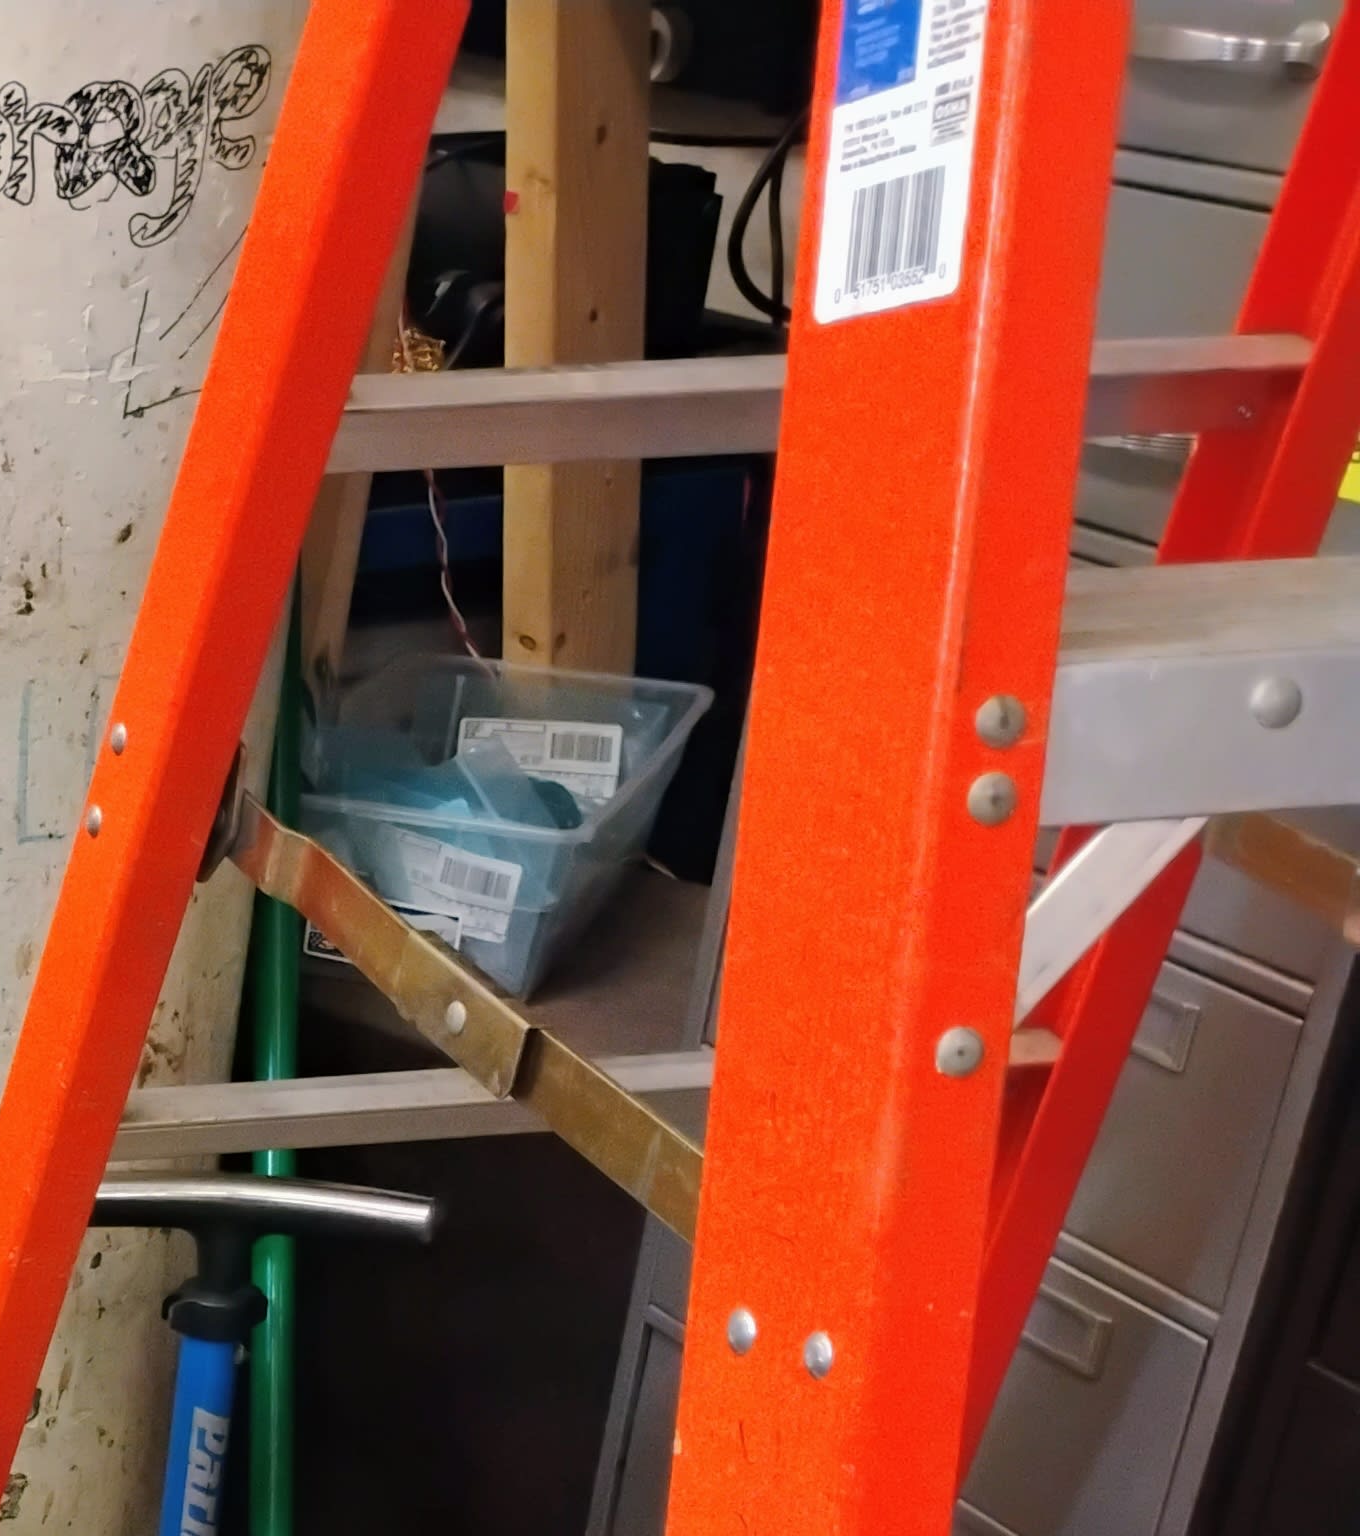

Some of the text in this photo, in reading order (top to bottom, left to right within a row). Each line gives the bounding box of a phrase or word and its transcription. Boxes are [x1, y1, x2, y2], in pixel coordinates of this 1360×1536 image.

[833, 287, 842, 304] 0
[851, 274, 888, 300] 51751
[937, 262, 947, 279] 0
